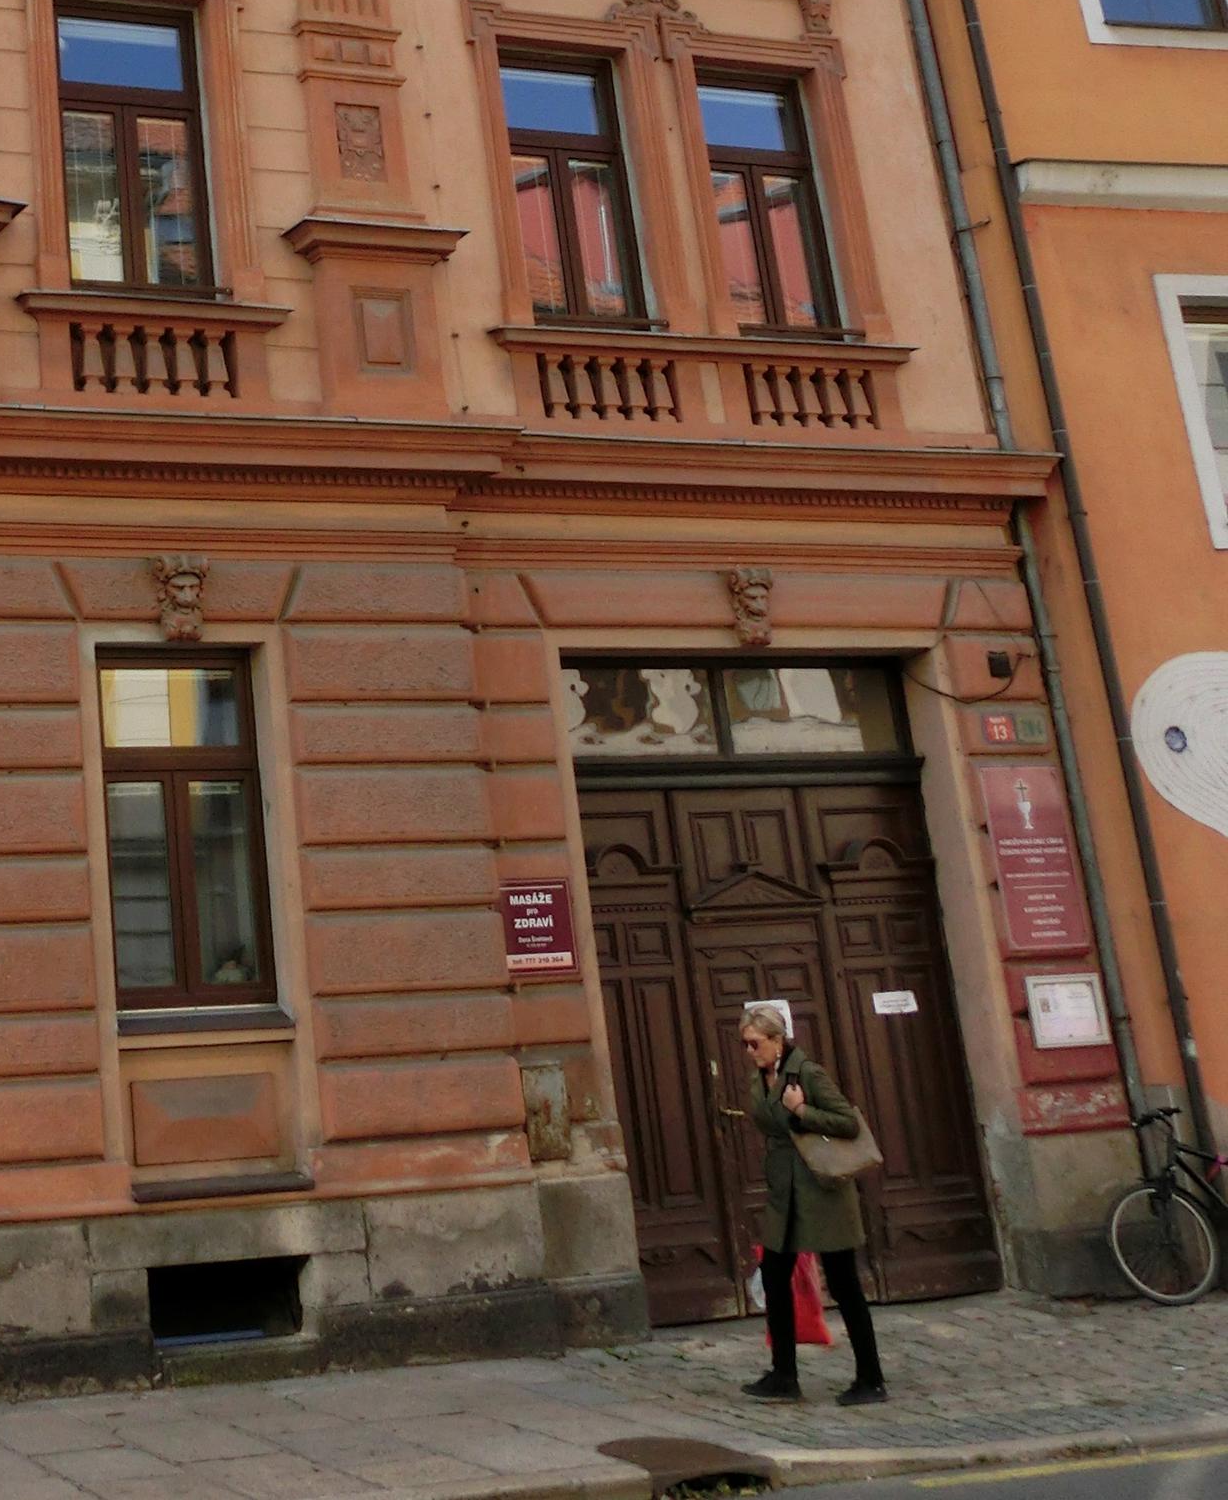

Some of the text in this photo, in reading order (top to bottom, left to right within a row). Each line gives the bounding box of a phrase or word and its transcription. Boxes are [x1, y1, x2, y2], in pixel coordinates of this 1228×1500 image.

[993, 724, 1007, 740] 13
[509, 891, 553, 905] MASÁŽE
[514, 915, 553, 928] ZDRAVÍ
